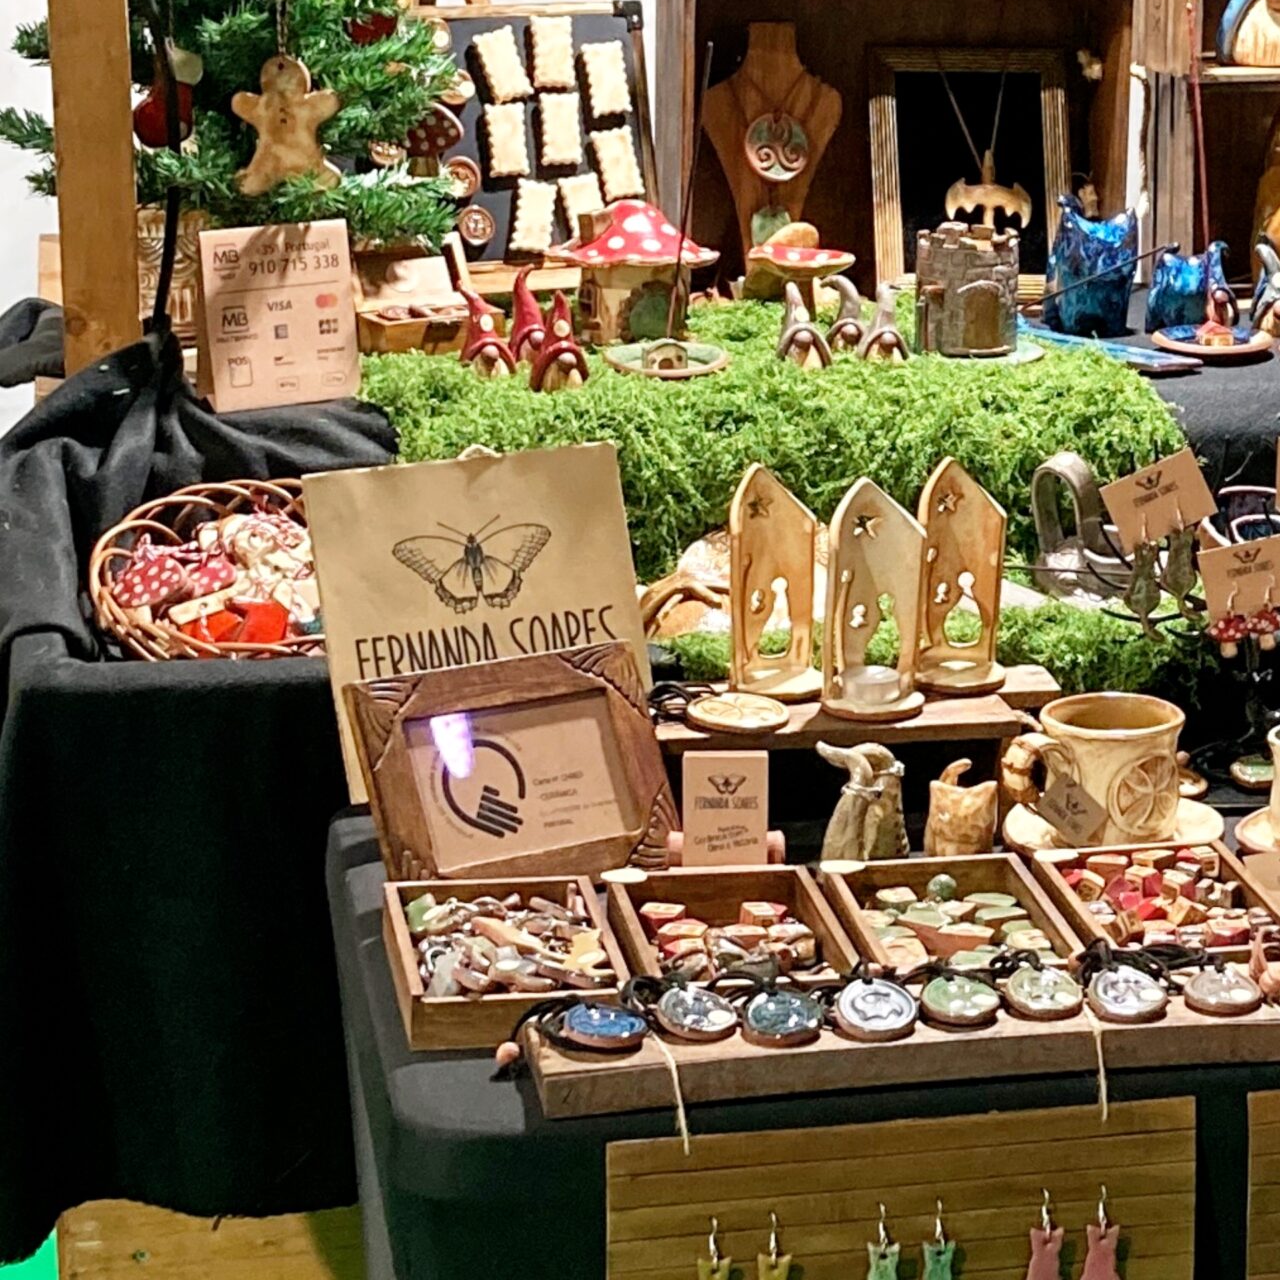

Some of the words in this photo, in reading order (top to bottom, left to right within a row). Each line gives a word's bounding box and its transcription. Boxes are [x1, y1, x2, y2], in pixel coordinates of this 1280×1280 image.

[213, 249, 239, 264] MB
[248, 260, 277, 276] 910
[280, 257, 308, 274] 715
[313, 254, 340, 270] 338
[267, 300, 293, 312] VISA
[222, 311, 249, 328] MB
